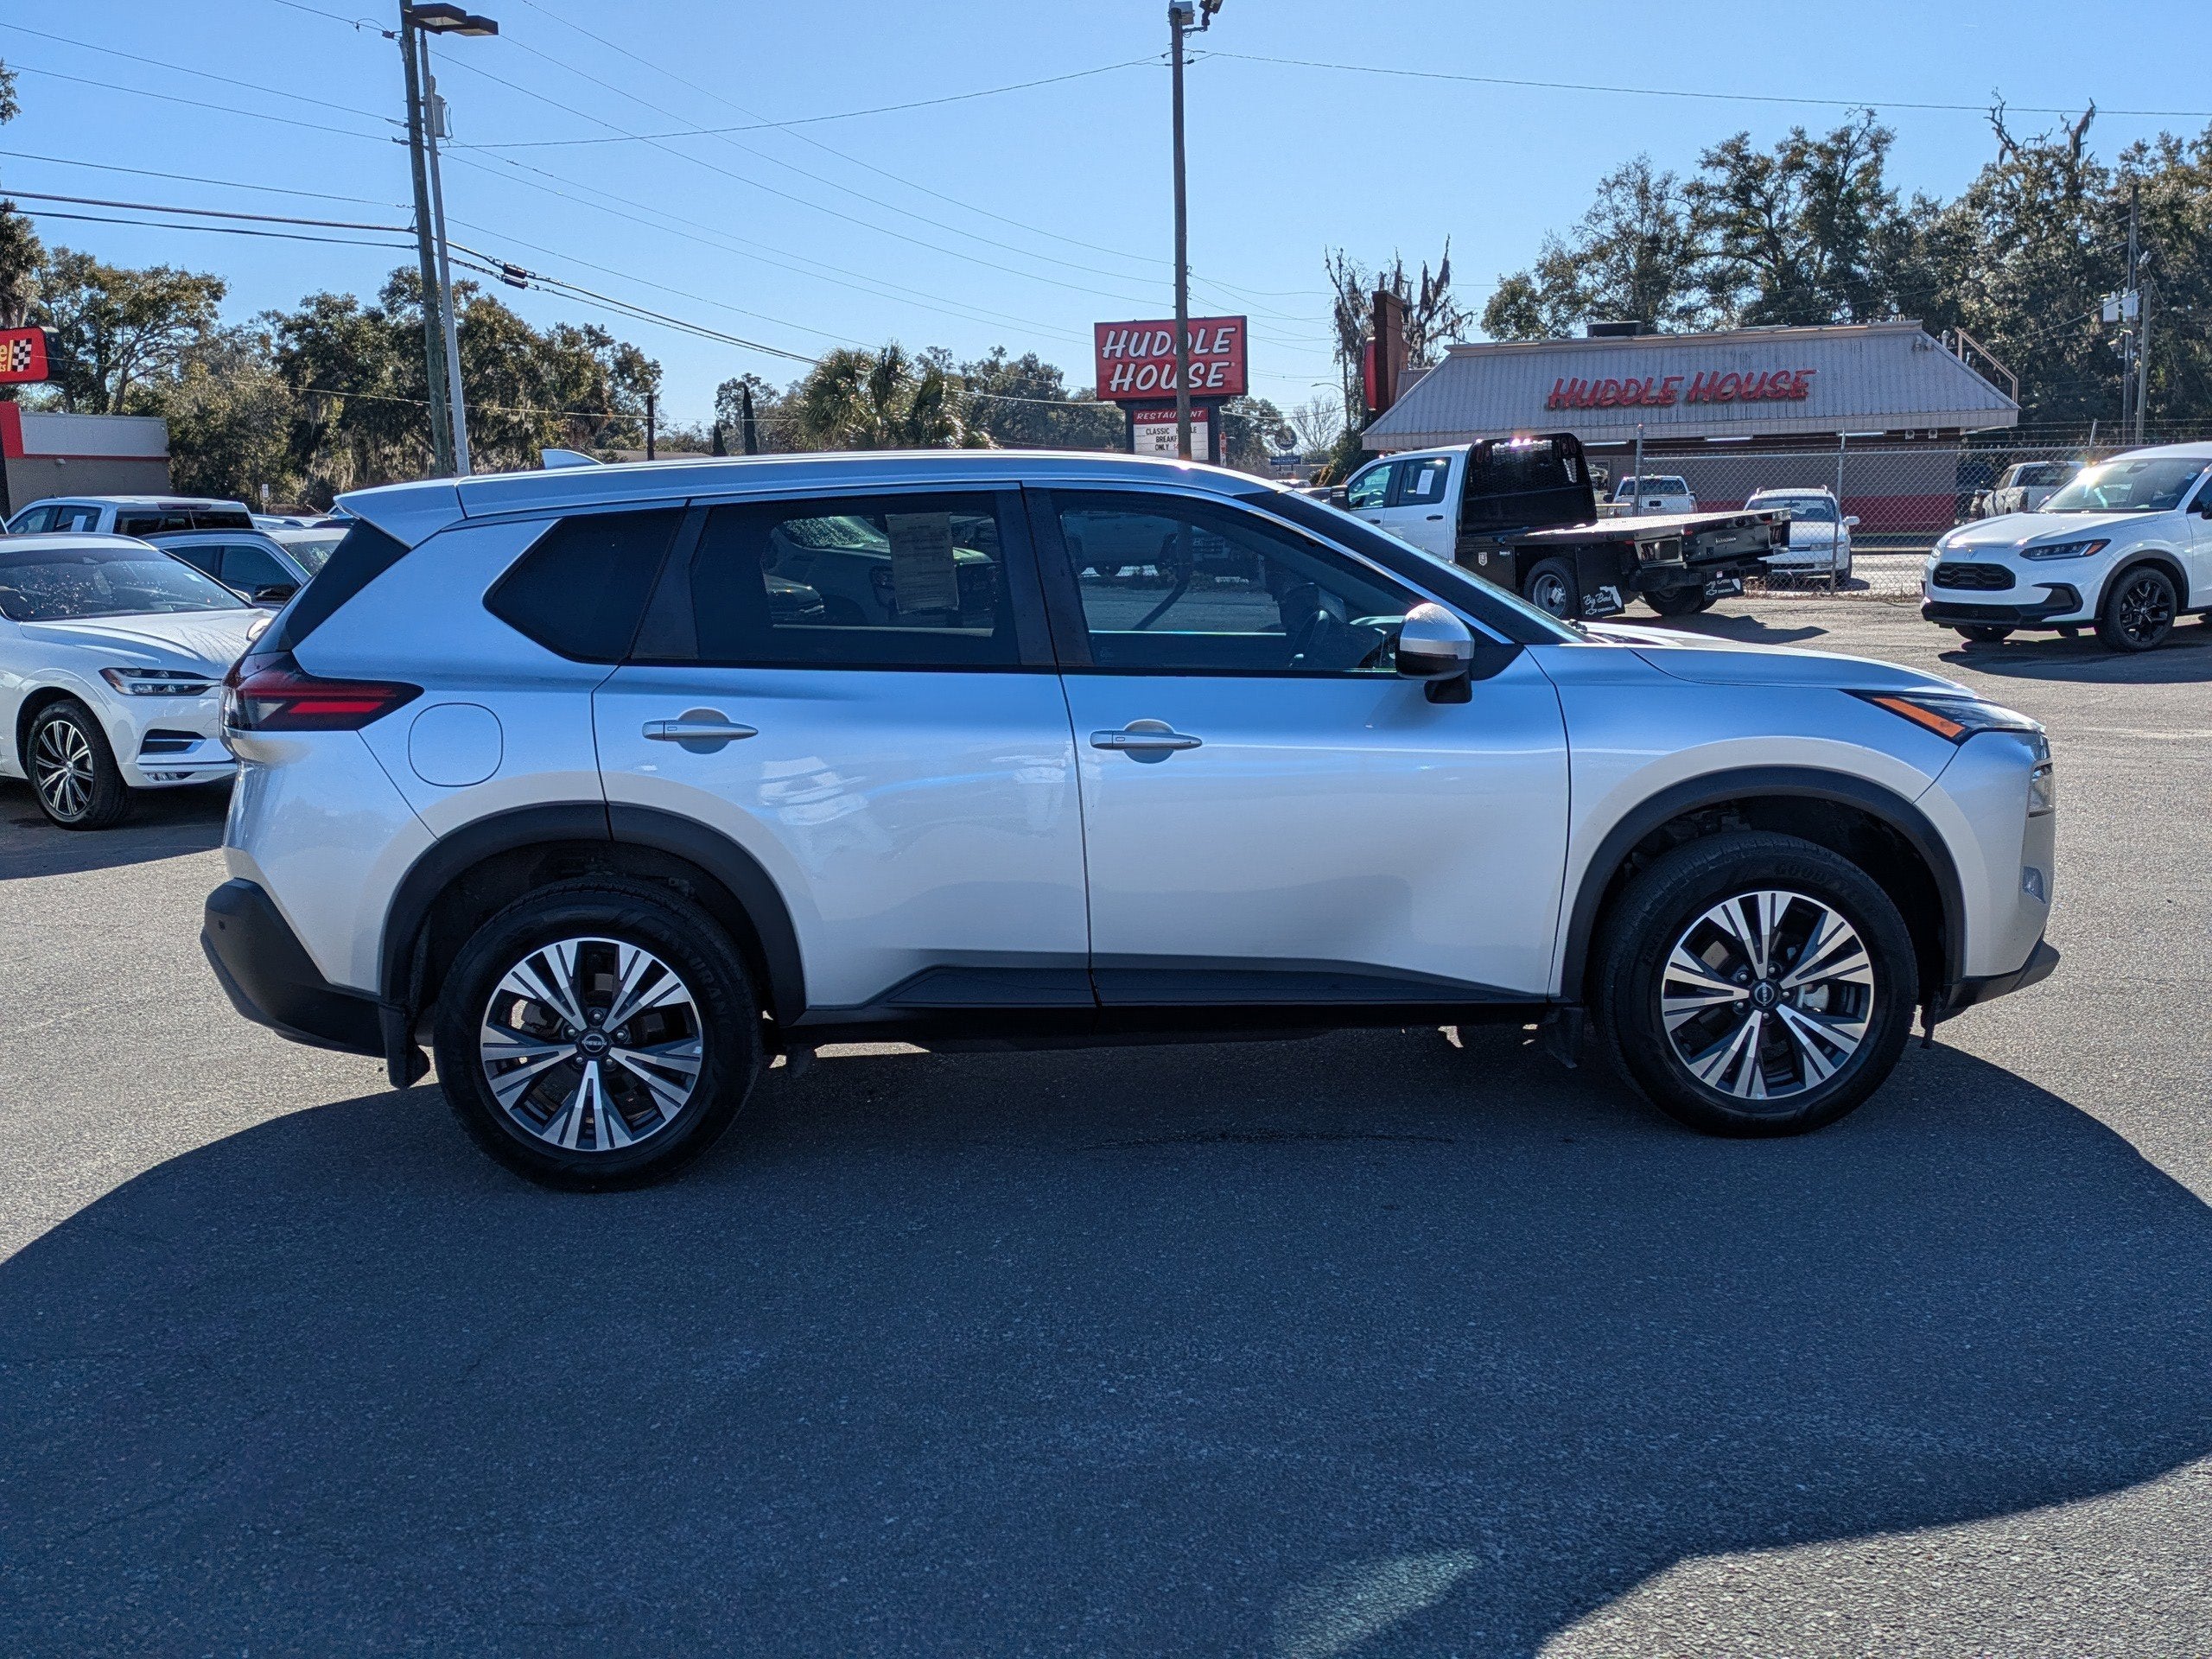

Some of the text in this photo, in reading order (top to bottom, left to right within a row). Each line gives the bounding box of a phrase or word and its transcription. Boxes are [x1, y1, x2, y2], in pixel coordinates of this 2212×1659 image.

[1103, 327, 1236, 359] HUDLE
[1109, 361, 1231, 391] HOUSE
[1548, 369, 1816, 408] HUDDLE HOUSE
[1136, 410, 1203, 420] RESTAUNT
[1146, 427, 1170, 435] CLASSIC
[1155, 435, 1178, 443] BREAKF
